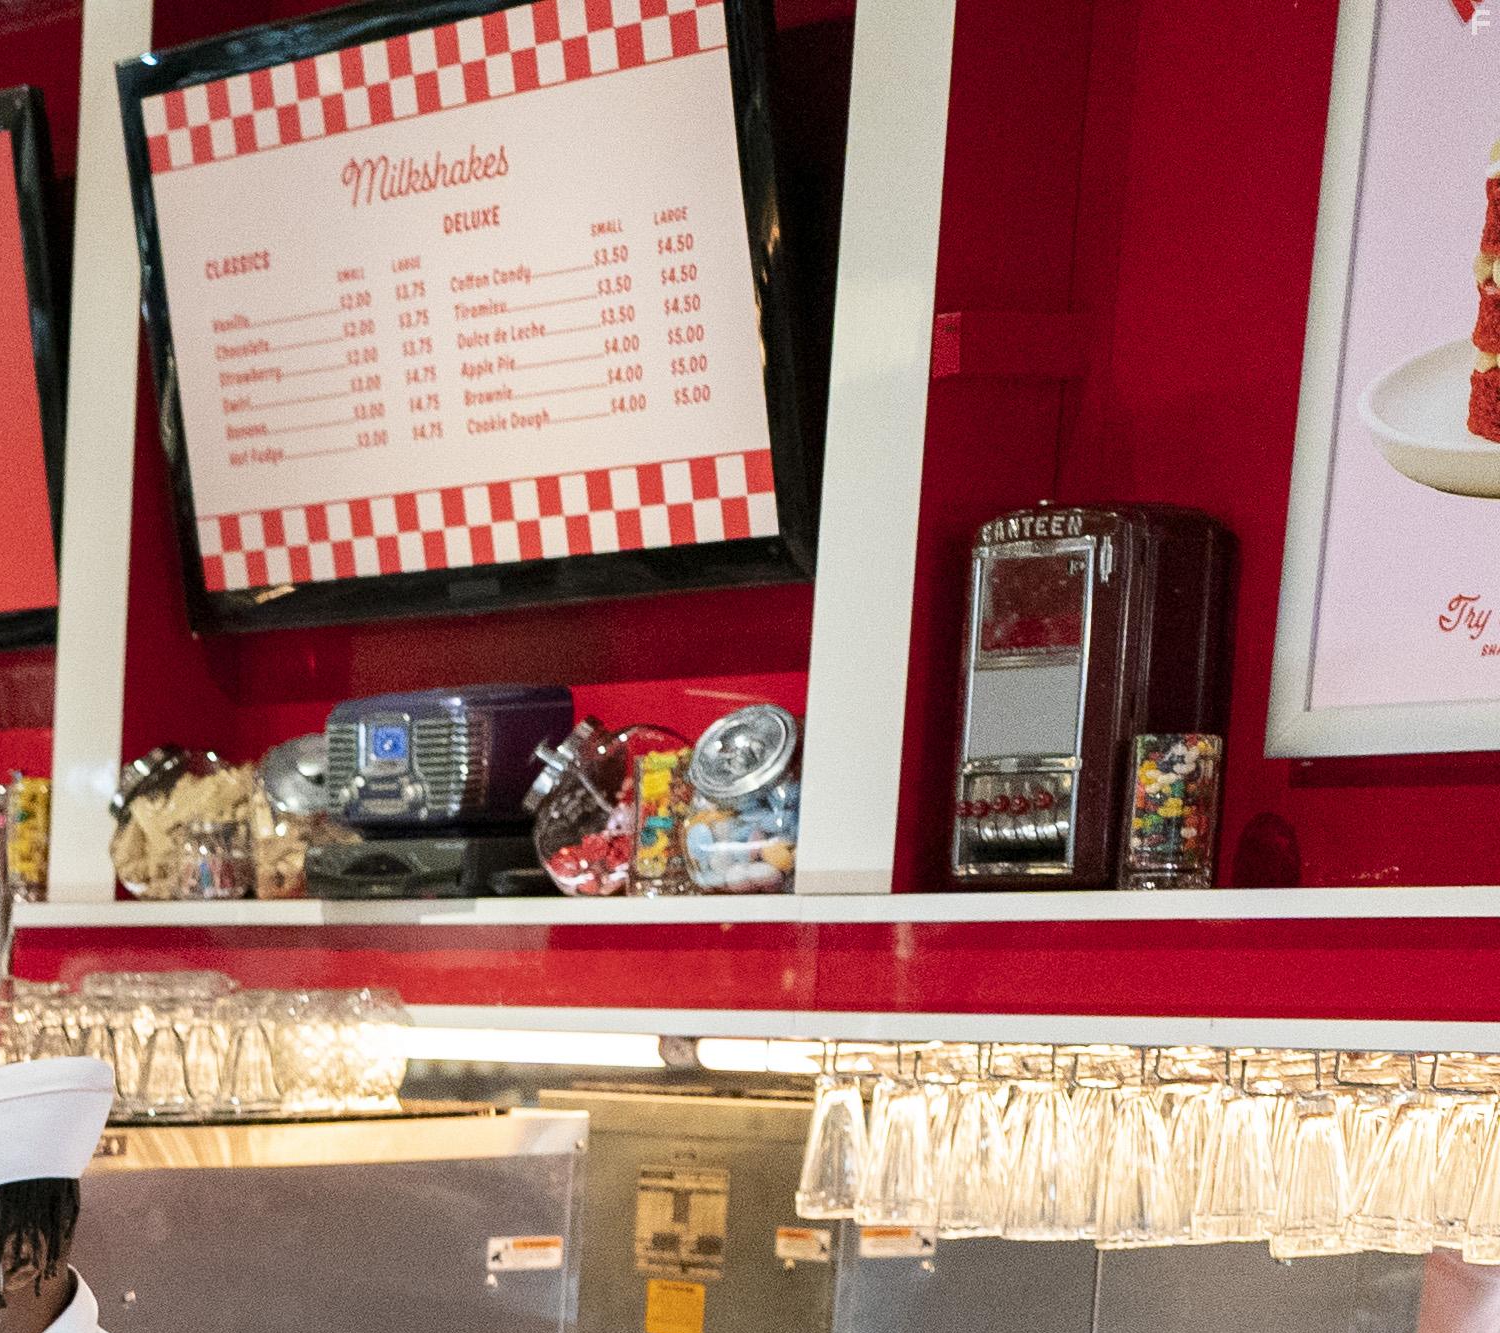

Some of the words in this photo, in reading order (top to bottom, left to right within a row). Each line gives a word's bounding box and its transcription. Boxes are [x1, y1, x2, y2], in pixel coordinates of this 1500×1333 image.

[341, 144, 509, 207] Milkshakes
[444, 205, 500, 234] DELUXE
[591, 219, 623, 237] SMALL
[654, 206, 688, 226] LARGE
[594, 244, 628, 267] $3.50
[658, 233, 694, 255] $4.50
[205, 251, 269, 280] CLASSICS
[598, 275, 632, 296] $3.50
[661, 263, 698, 285] $4.50
[511, 322, 546, 342] Leche
[601, 305, 635, 326] $3.50
[664, 293, 701, 316] $4.50
[604, 334, 639, 354] $4.00
[668, 324, 704, 345] $5.00
[608, 364, 643, 384] $4.00
[671, 354, 708, 376] $5.00
[611, 393, 647, 414] $4.00
[674, 384, 711, 406] $5.00
[982, 515, 1083, 543] CANTEEN
[1438, 593, 1492, 640] Try
